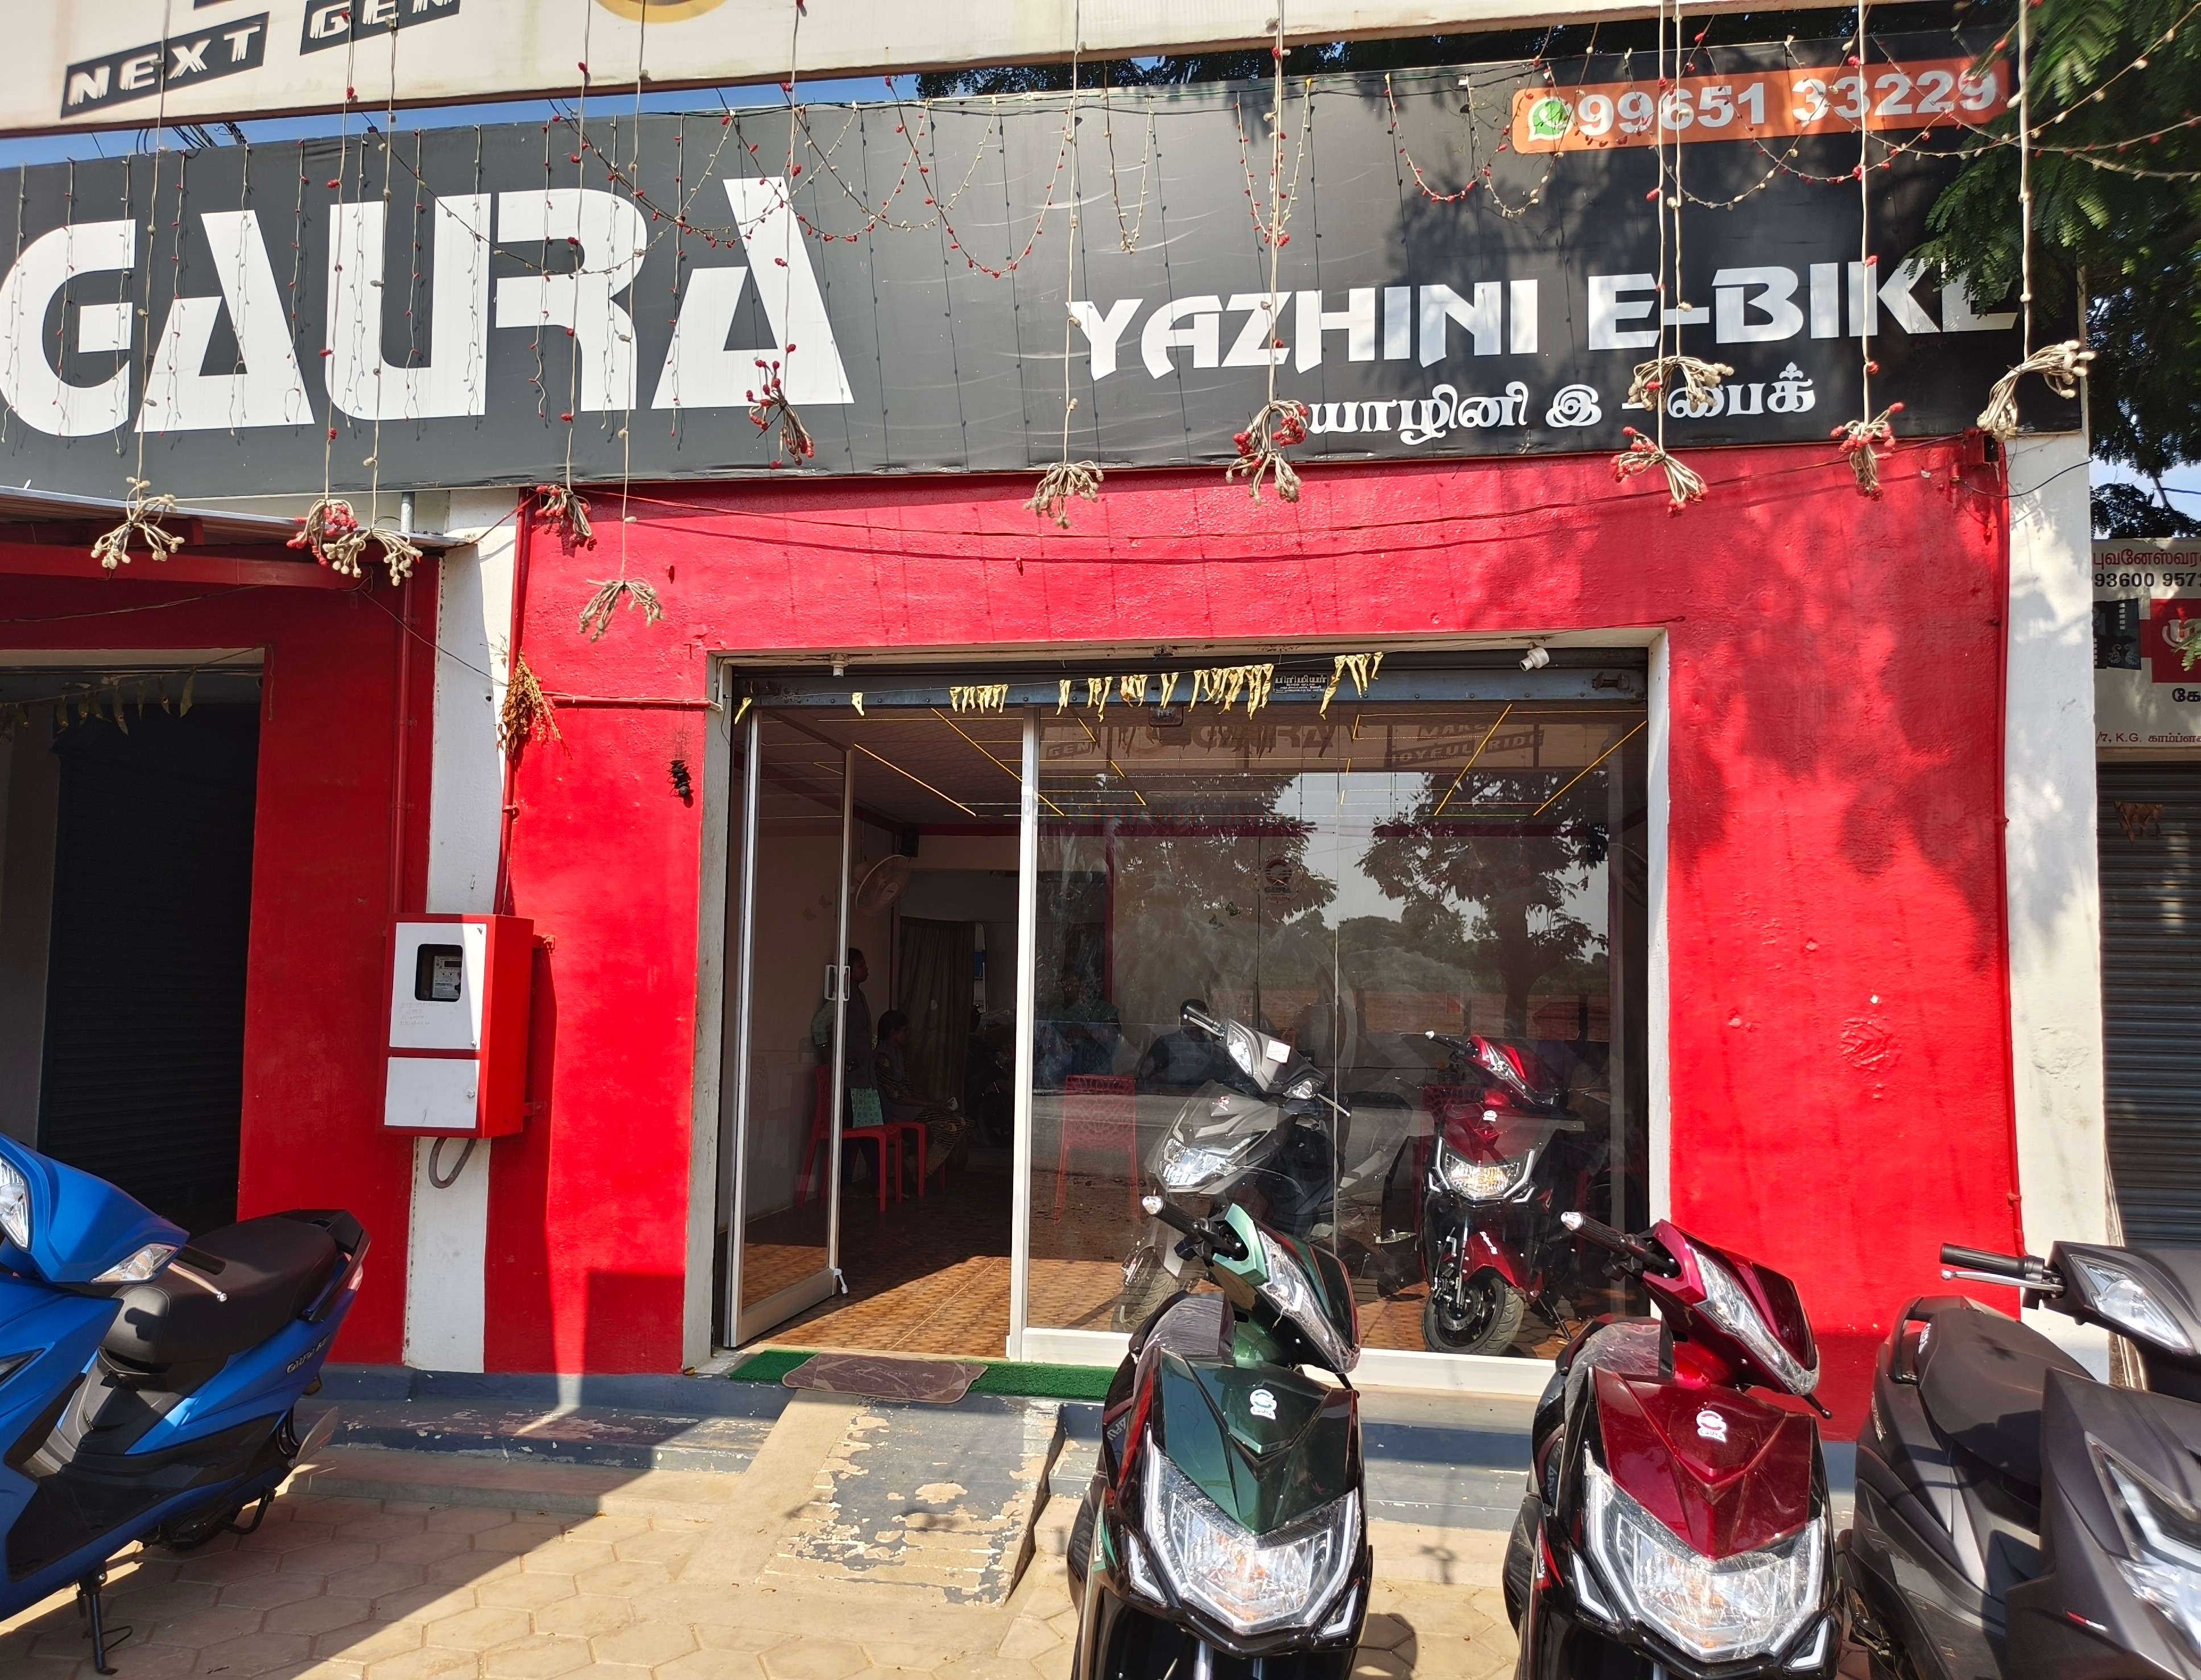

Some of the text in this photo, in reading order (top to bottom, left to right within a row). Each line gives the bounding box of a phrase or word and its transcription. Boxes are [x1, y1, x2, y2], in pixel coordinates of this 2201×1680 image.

[67, 26, 261, 106] NEXT
[1577, 69, 1998, 136] 99651 33229
[0, 176, 854, 437] GAURA
[1065, 279, 1539, 381] YAZHINI
[1308, 380, 1529, 446] யாழினி
[1545, 384, 1603, 428] இ
[1666, 361, 1816, 418] பைக்
[2093, 548, 2201, 570] புவனேஸ்வர
[2094, 572, 2201, 587] 93600 957
